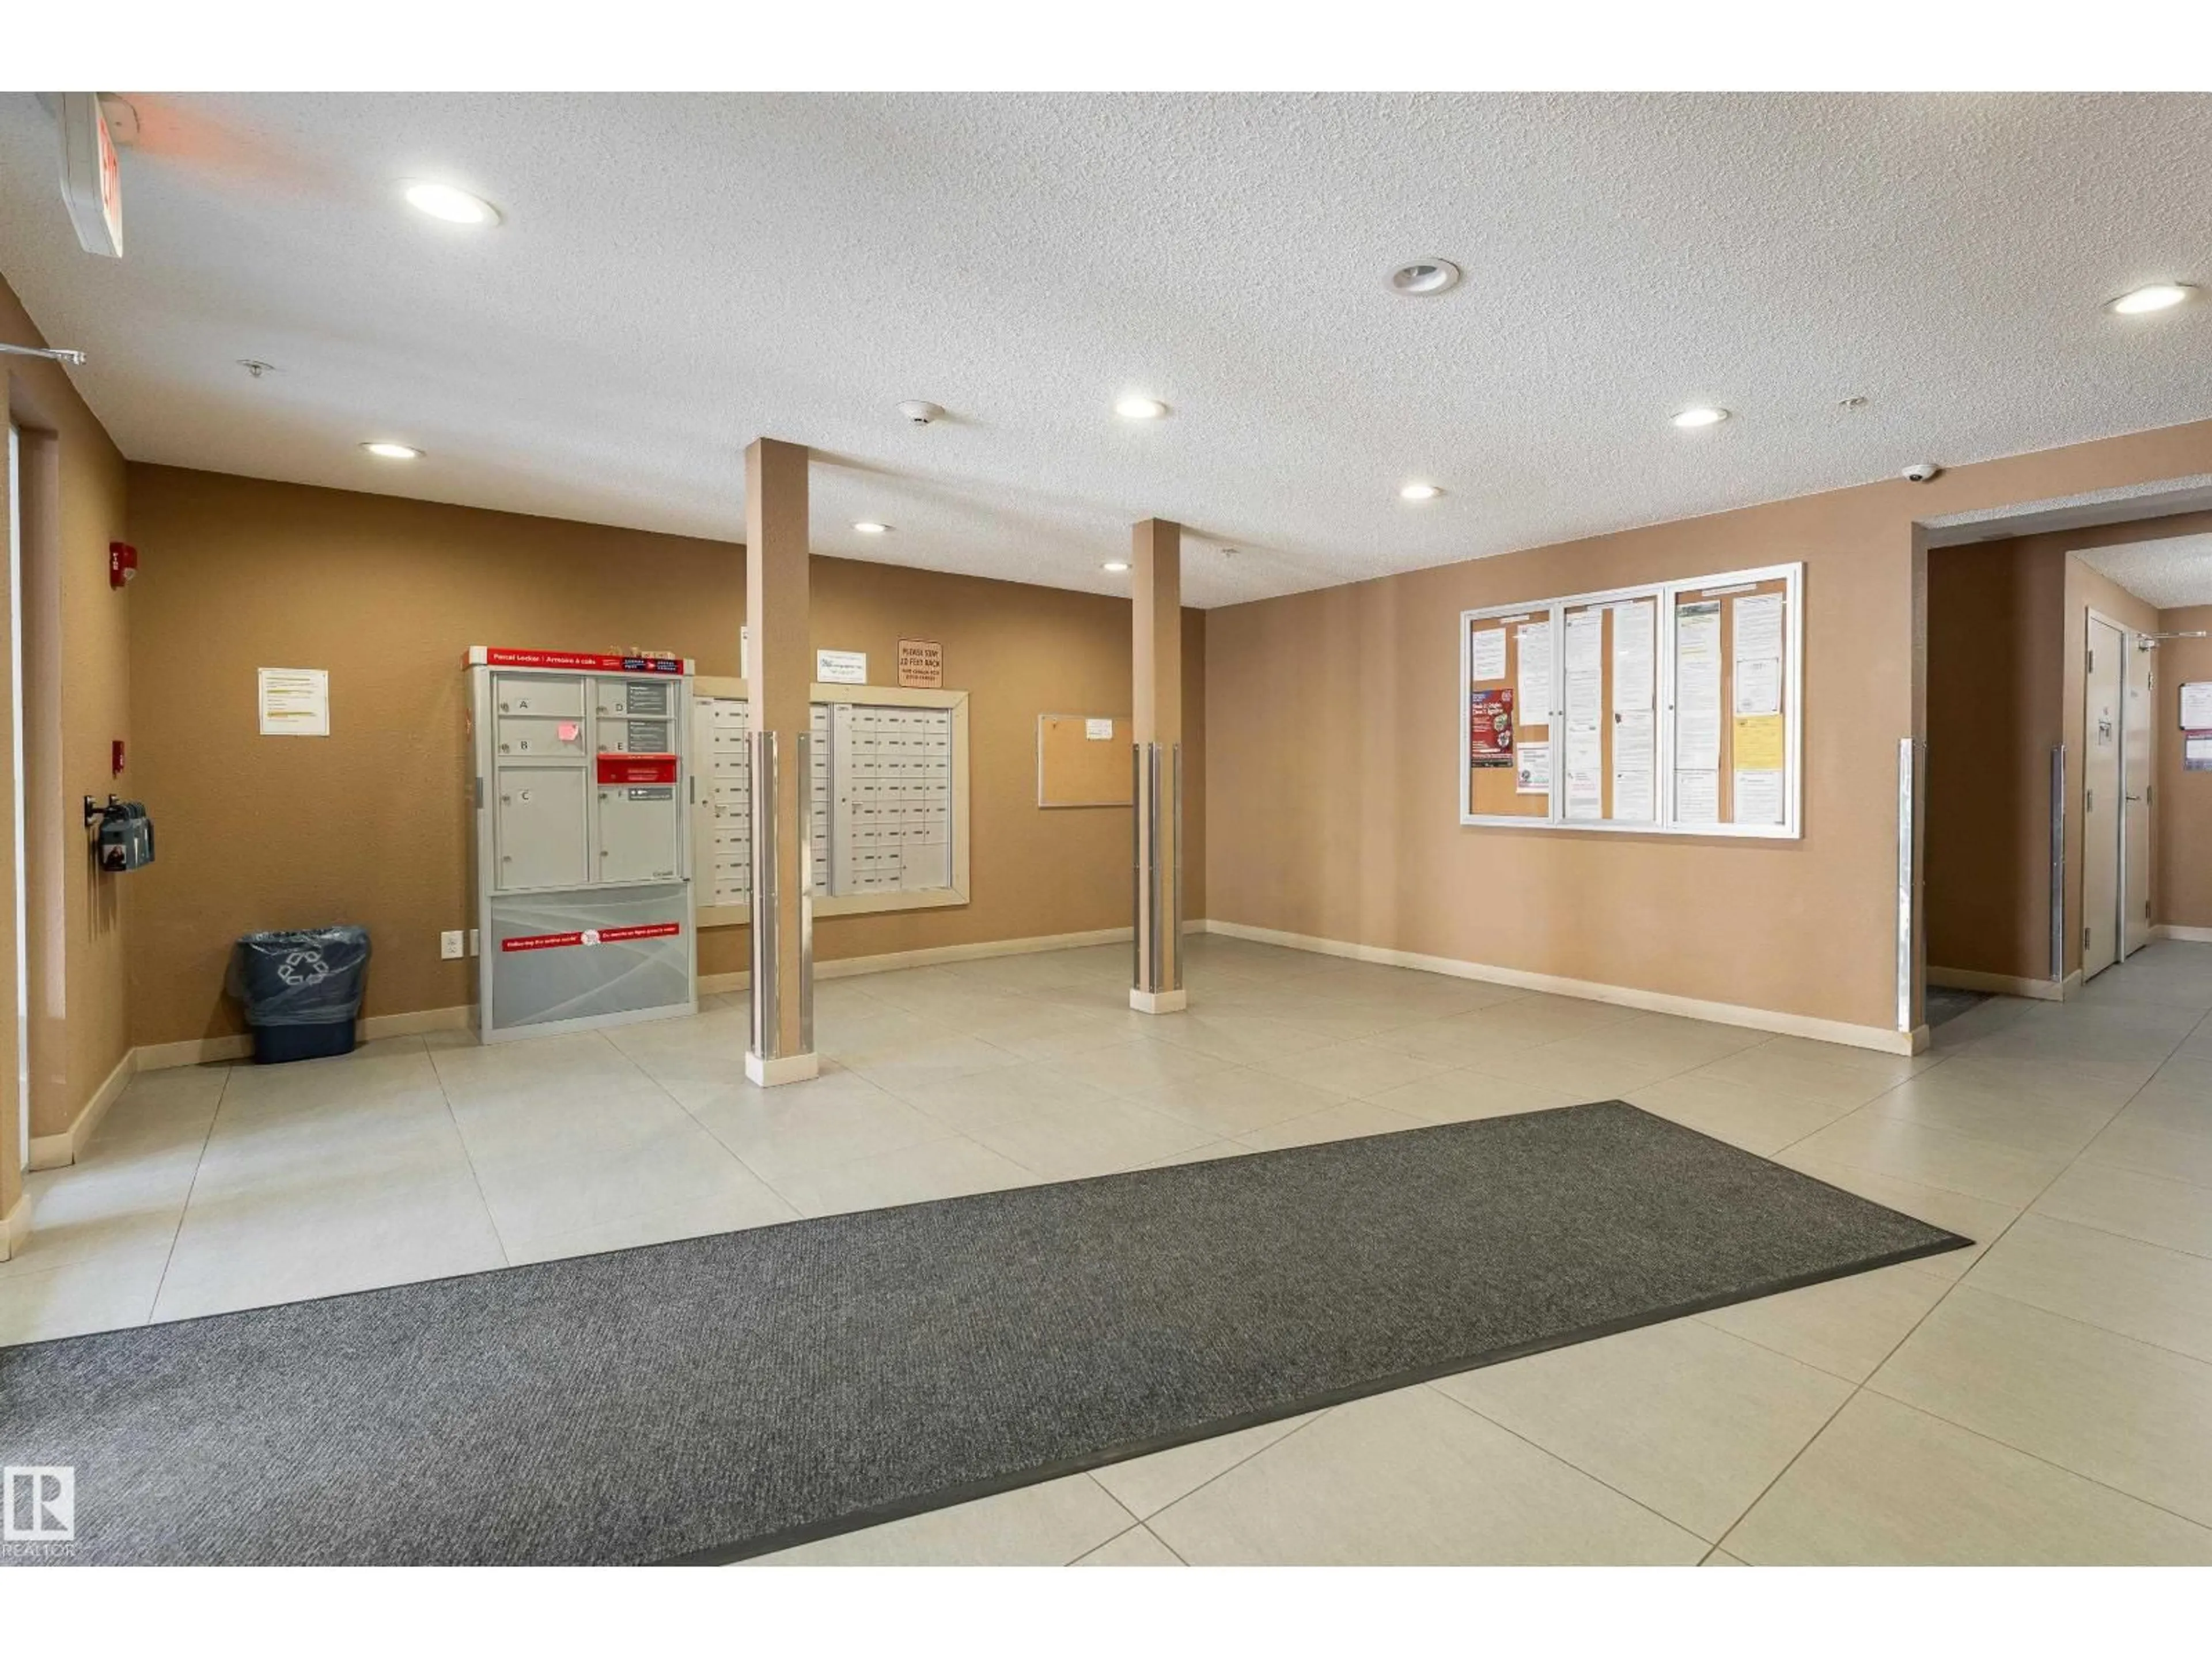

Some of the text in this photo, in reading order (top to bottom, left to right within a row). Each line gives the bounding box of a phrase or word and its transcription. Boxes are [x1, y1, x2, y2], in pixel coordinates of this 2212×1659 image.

[903, 648, 938, 657] PLEASE STAY
[925, 659, 940, 667] BACK
[520, 700, 528, 709] A
[615, 703, 623, 711] D
[521, 741, 528, 749] B
[522, 791, 529, 800] C
